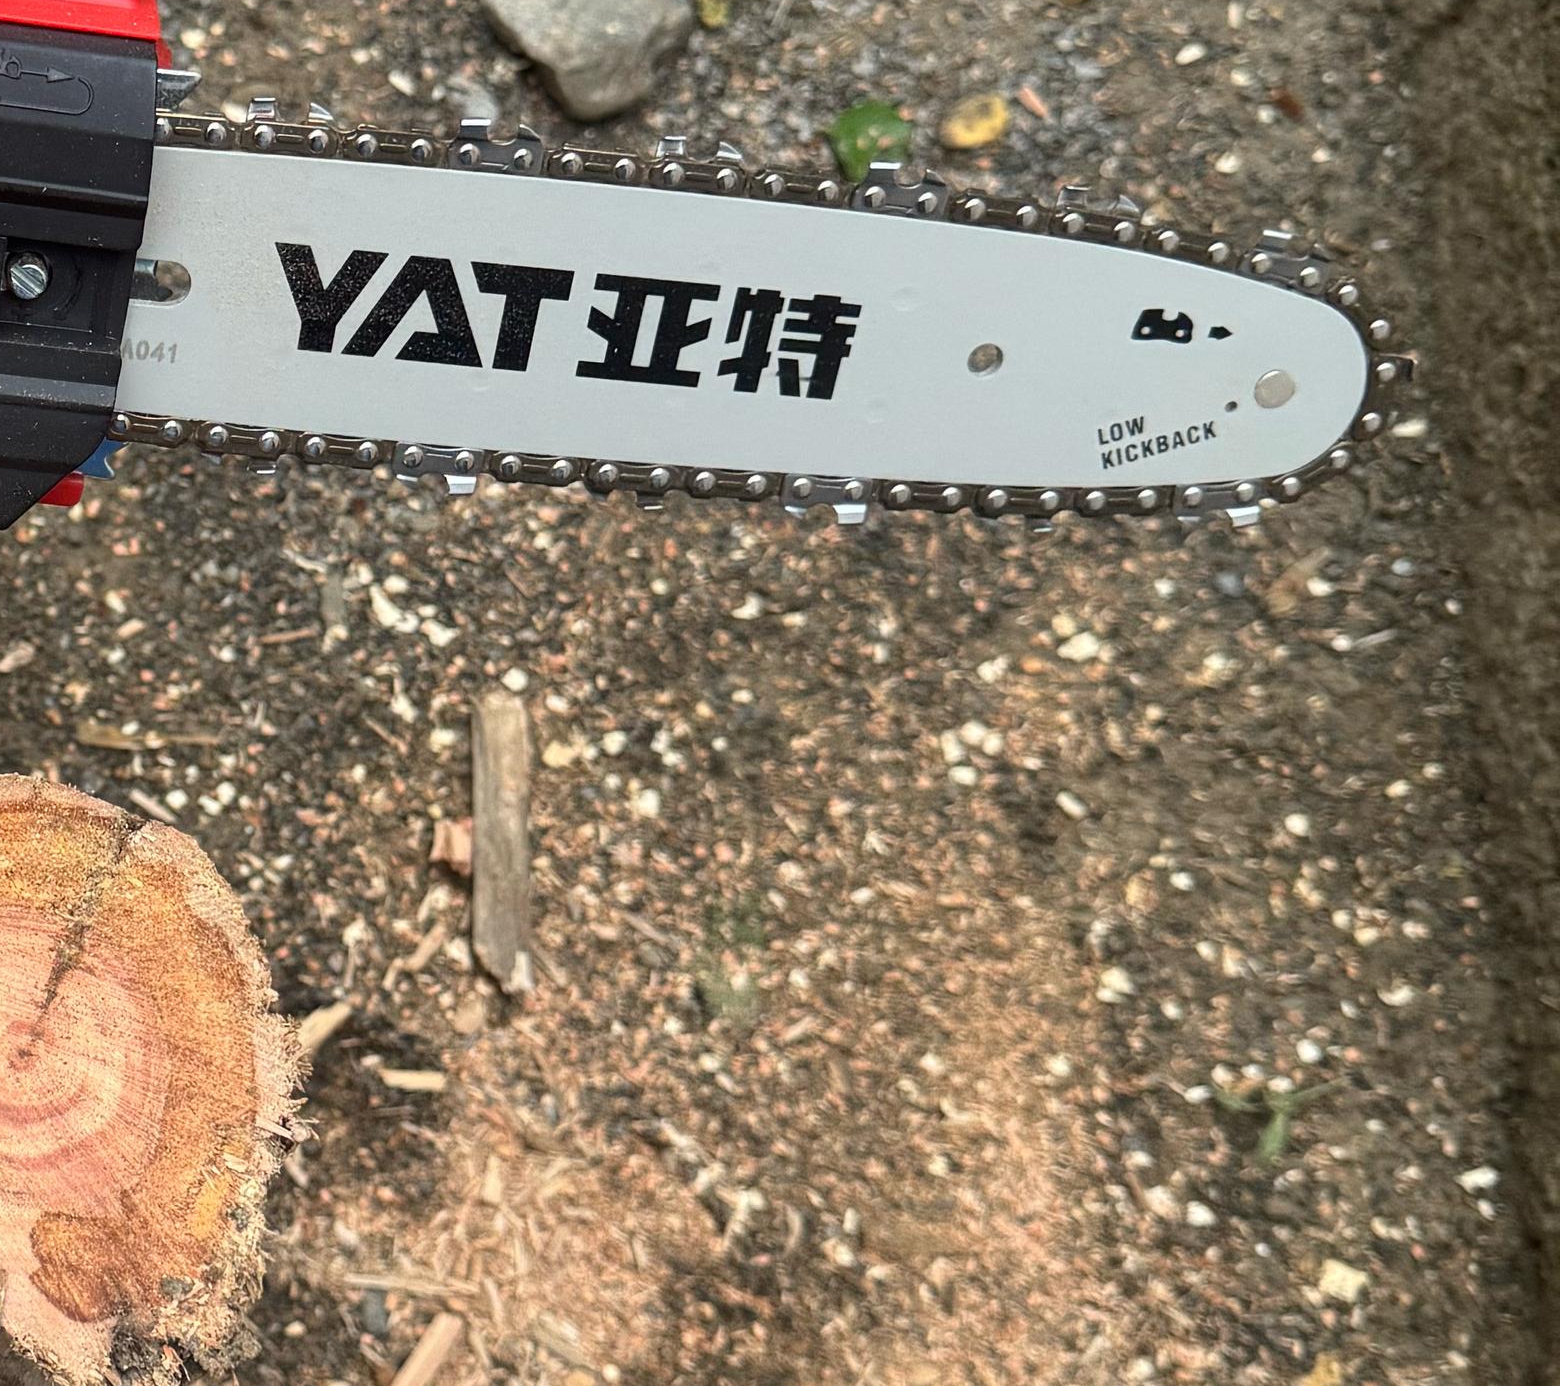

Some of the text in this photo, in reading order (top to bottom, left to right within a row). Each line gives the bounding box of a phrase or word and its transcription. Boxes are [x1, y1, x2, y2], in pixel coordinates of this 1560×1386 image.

[274, 241, 863, 401] YAT 亚特
[1098, 416, 1145, 445] LOW
[1101, 420, 1217, 469] KICKBACK
